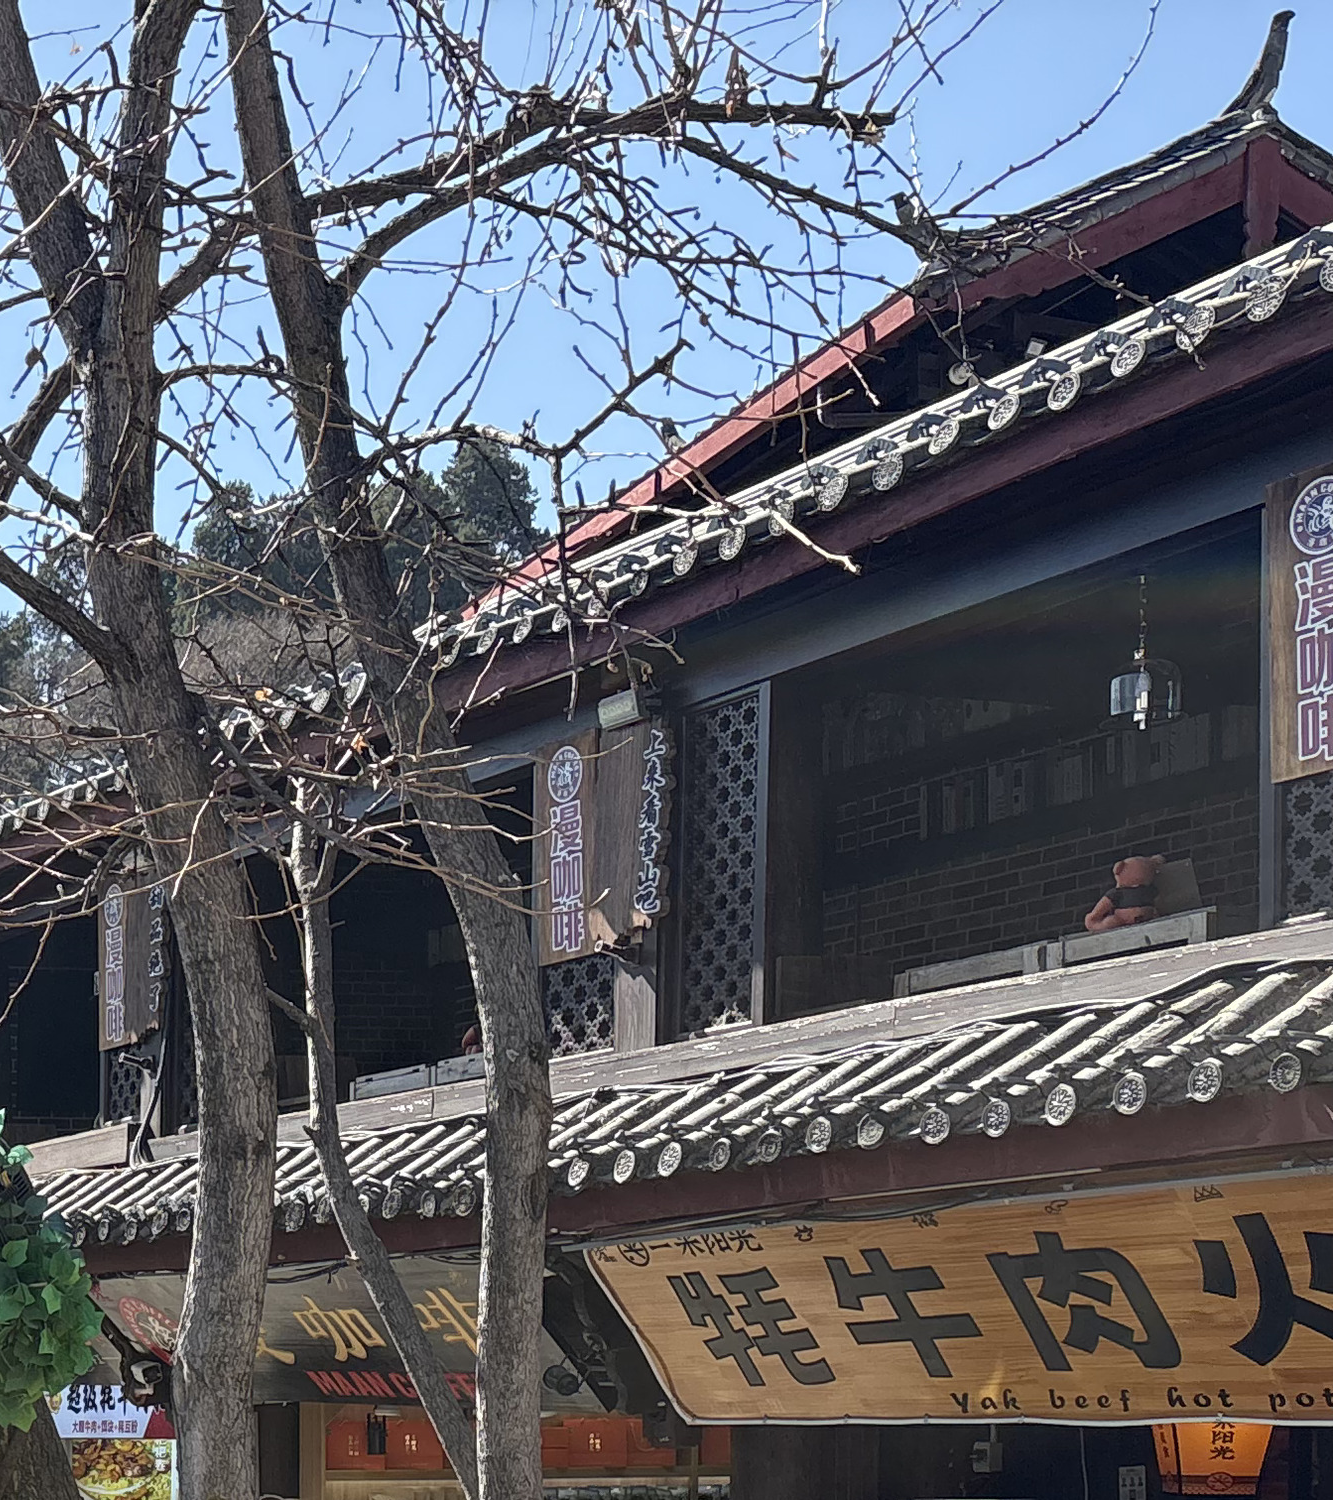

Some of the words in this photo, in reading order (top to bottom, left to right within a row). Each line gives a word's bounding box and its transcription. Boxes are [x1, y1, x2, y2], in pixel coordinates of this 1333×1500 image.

[550, 800, 585, 952] 漫咖啡
[105, 926, 125, 1043] 漫咖啡
[256, 1287, 479, 1365] 咖啡
[305, 1370, 397, 1398] MAAN
[1048, 1388, 1131, 1410] beef
[1167, 1386, 1234, 1409] hot
